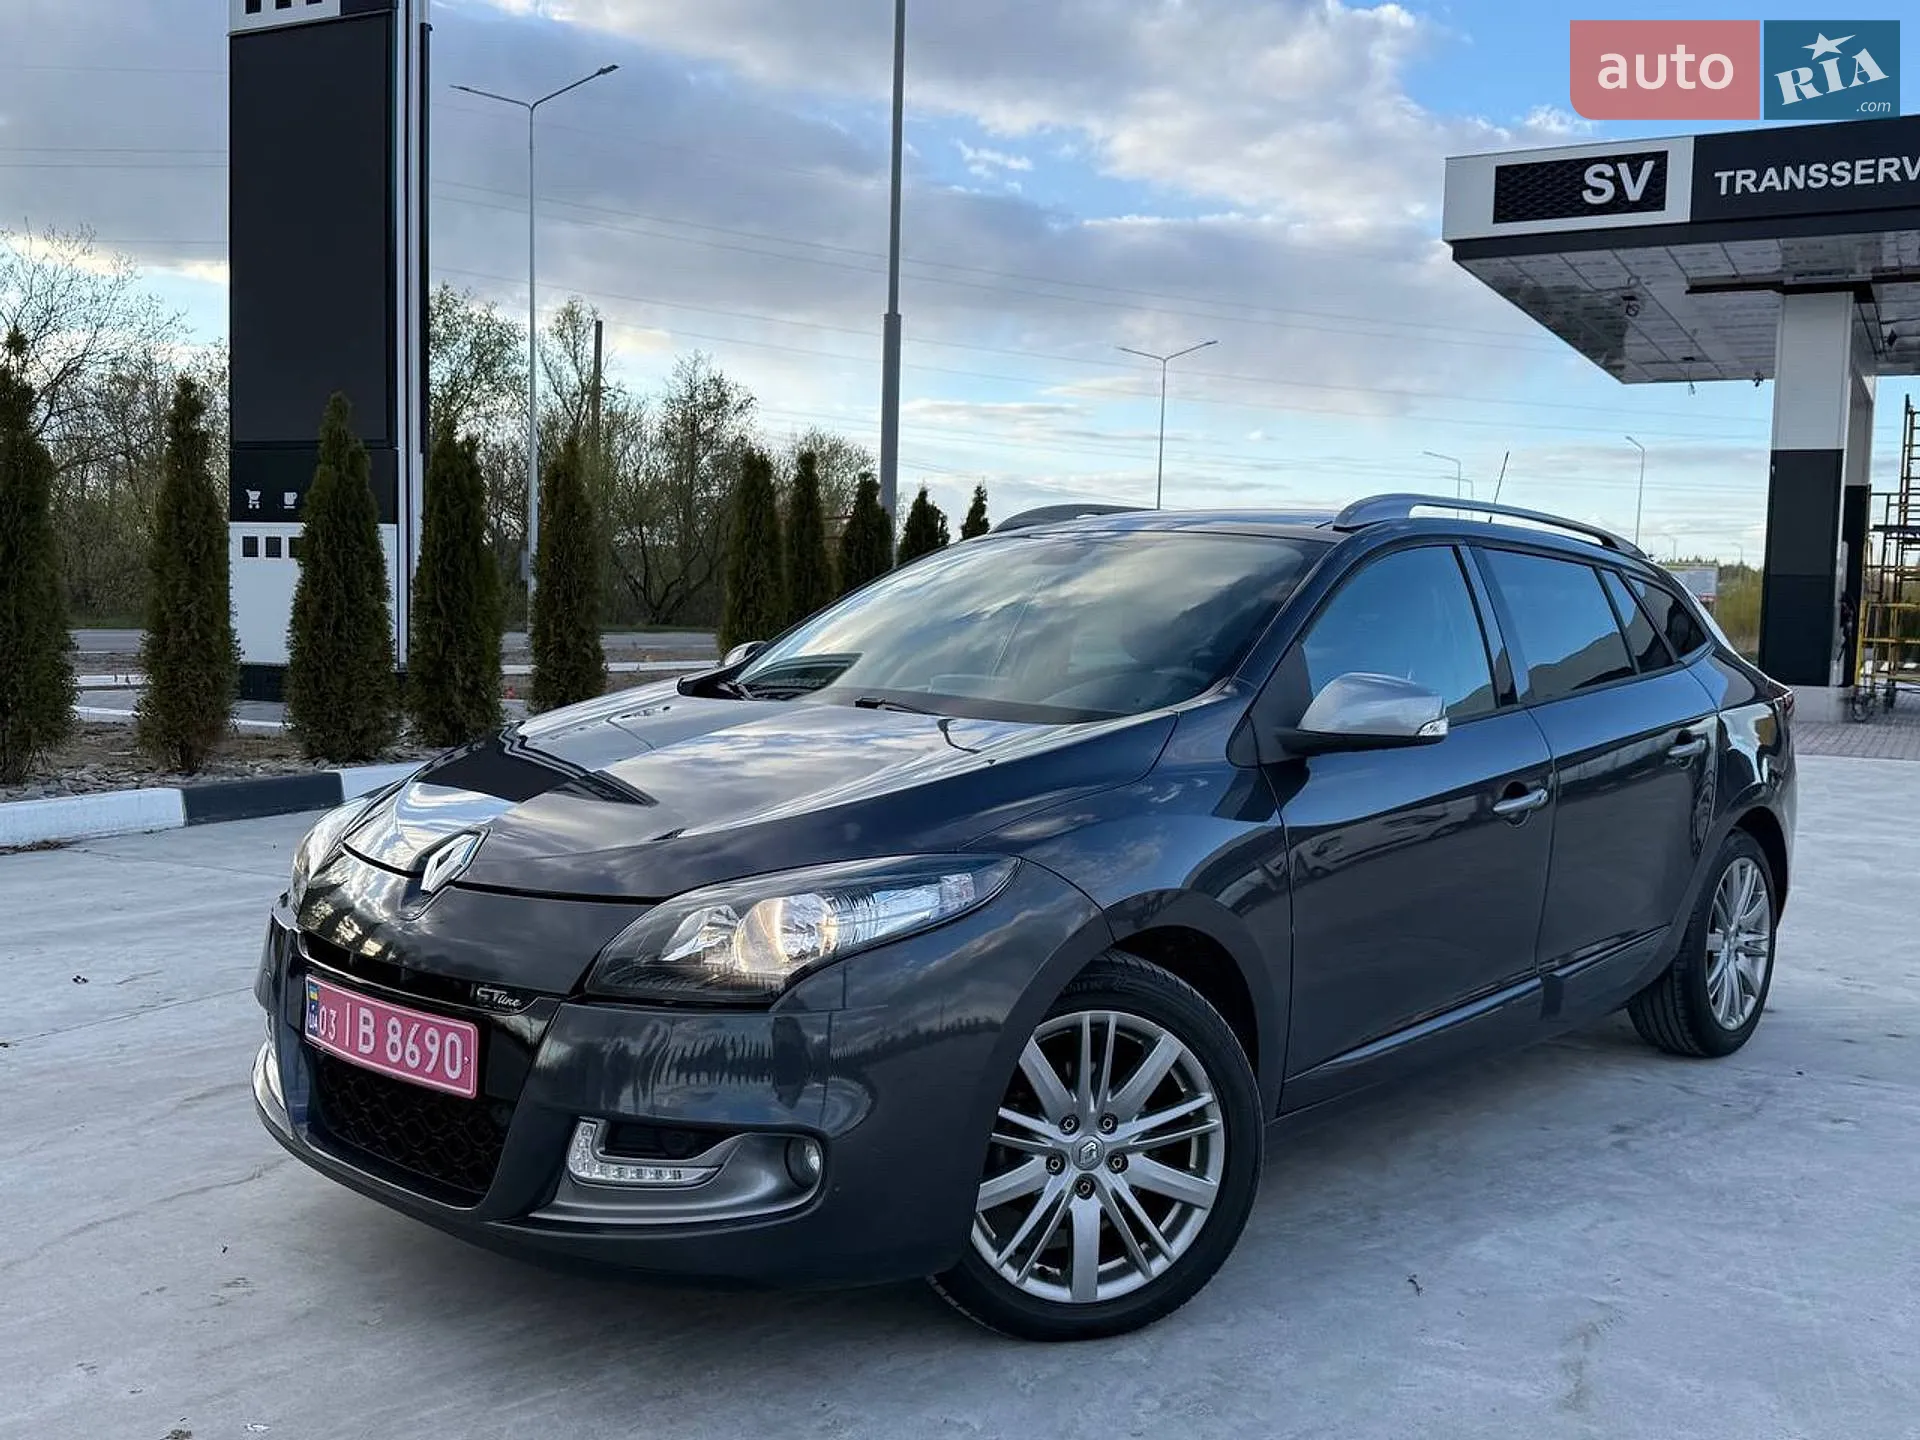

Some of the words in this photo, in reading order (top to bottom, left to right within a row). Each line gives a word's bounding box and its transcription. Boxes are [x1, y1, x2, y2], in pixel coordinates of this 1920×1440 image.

[1582, 160, 1654, 204] SV
[1714, 156, 1920, 196] TRANSSERV
[386, 1017, 463, 1080] 8690
